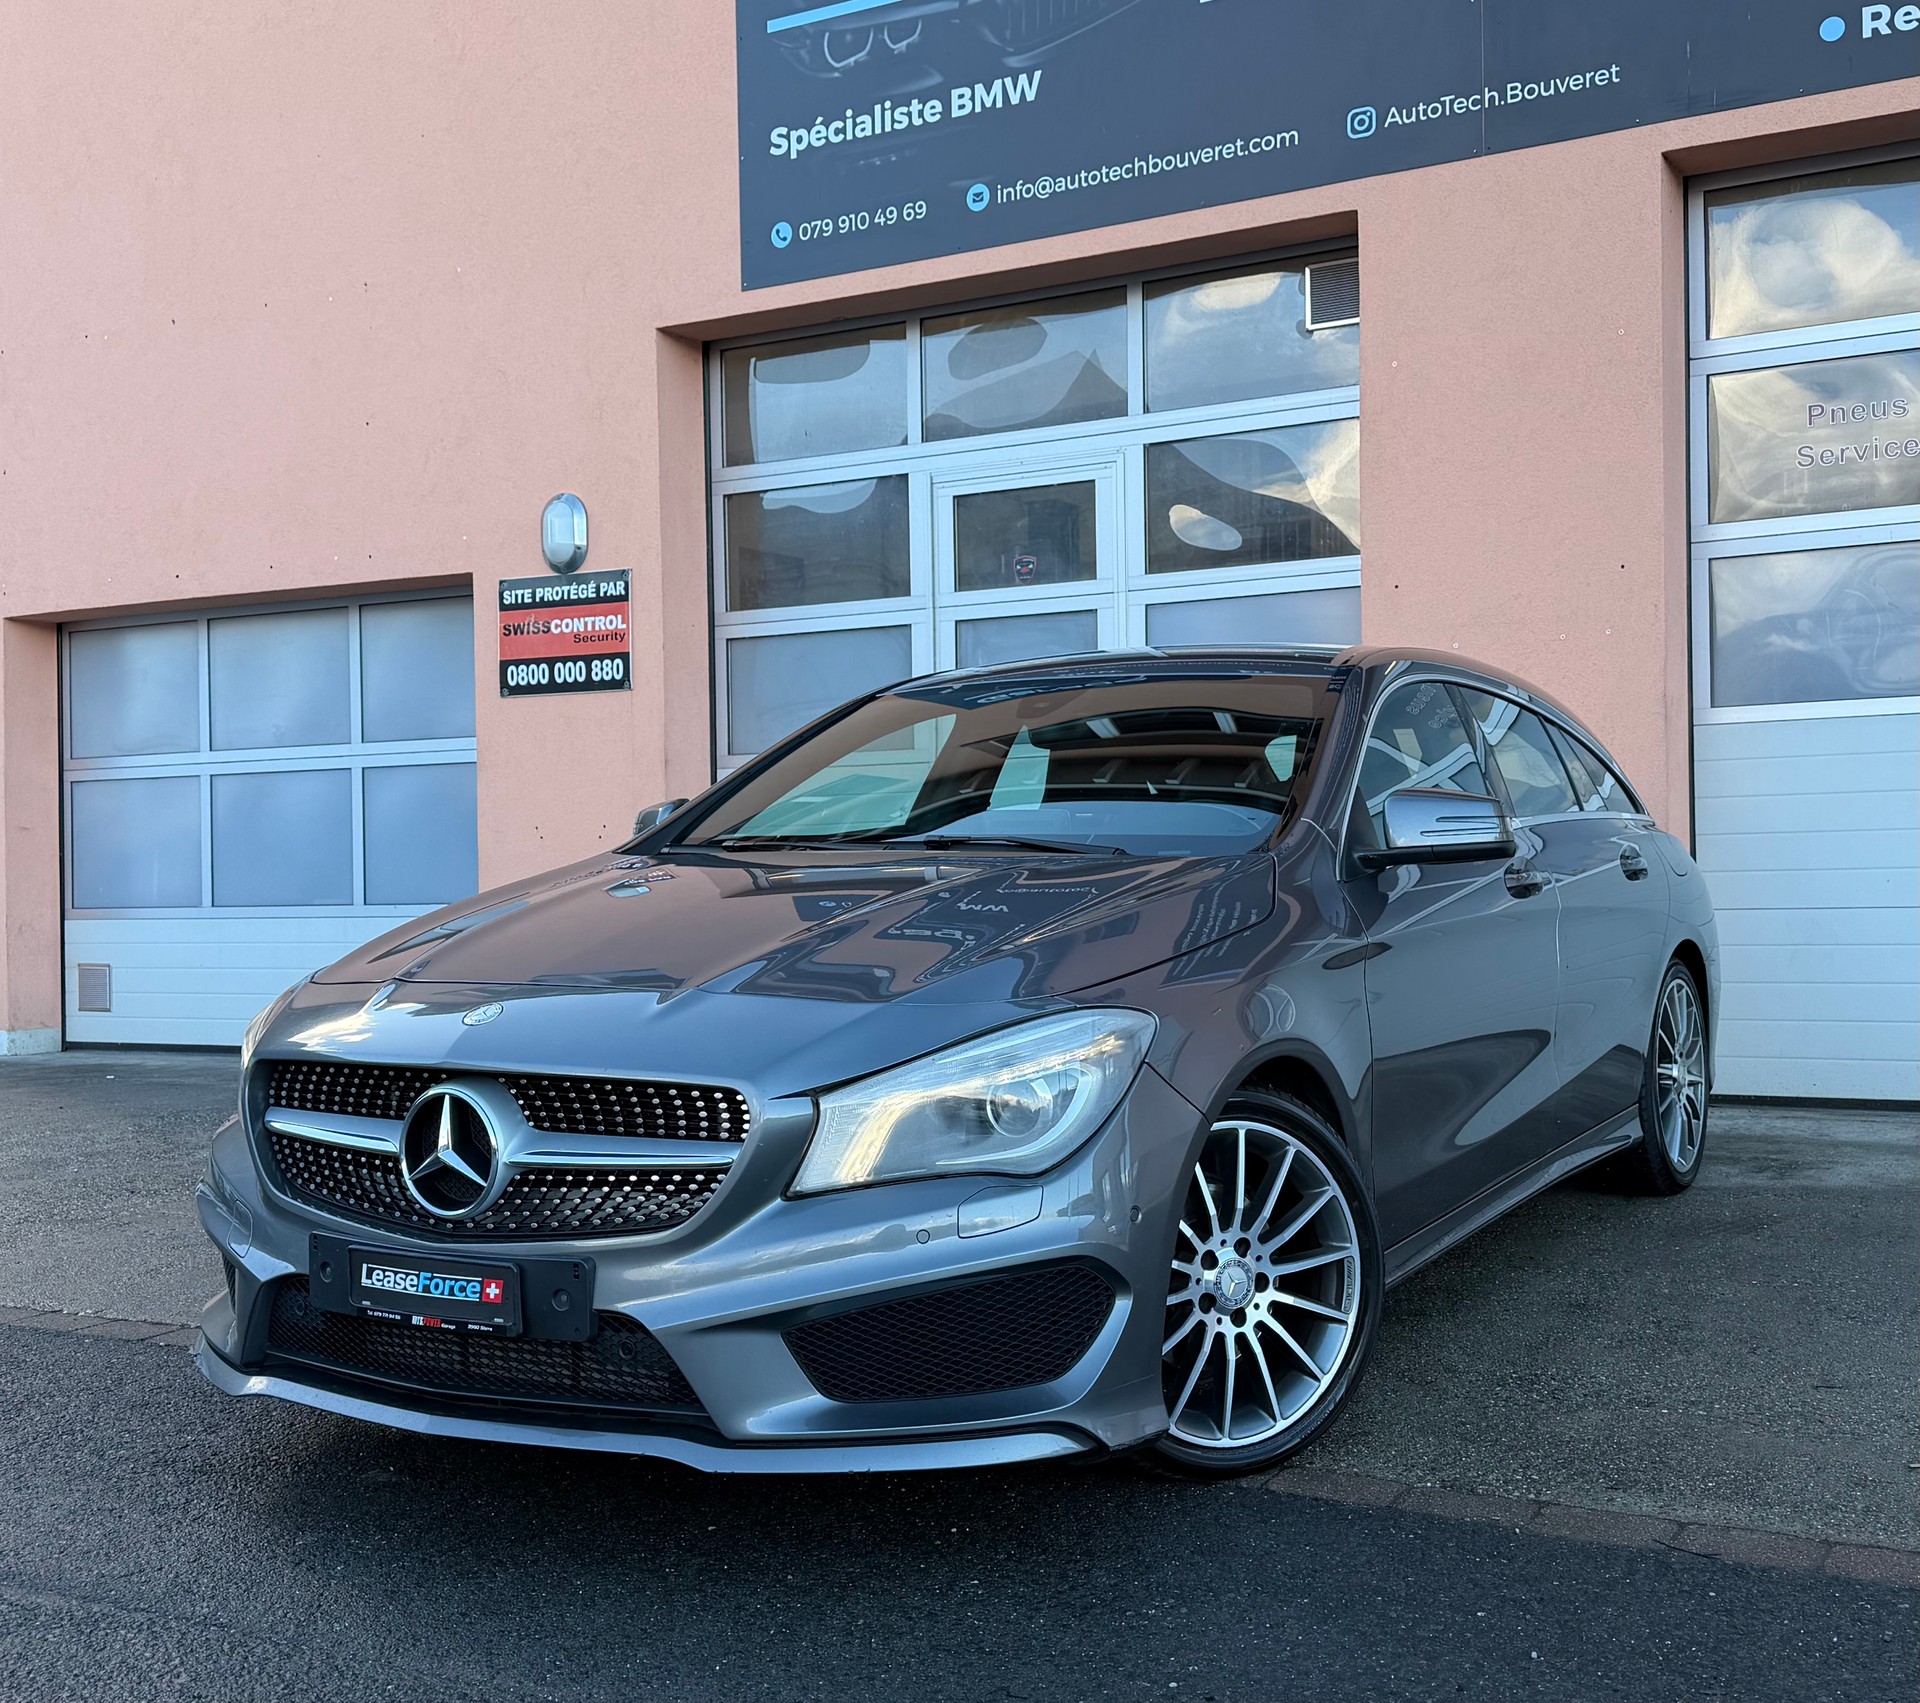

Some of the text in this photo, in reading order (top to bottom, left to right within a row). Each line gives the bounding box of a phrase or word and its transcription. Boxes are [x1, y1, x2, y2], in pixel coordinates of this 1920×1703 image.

[1384, 63, 1621, 129] AutoTech.Bouveret
[769, 70, 1043, 158] Spécialiste BMW
[996, 129, 1299, 204] info@autotechbouveret.com
[798, 200, 928, 241] 079 910 49 69
[1806, 398, 1909, 428] Pneus
[1796, 436, 1920, 468] Service
[503, 580, 626, 604] SITE PROTÉGÉ PAR
[573, 631, 626, 643] Security
[507, 658, 624, 686] 0800 000 880
[361, 1263, 481, 1299] LeaseForce
